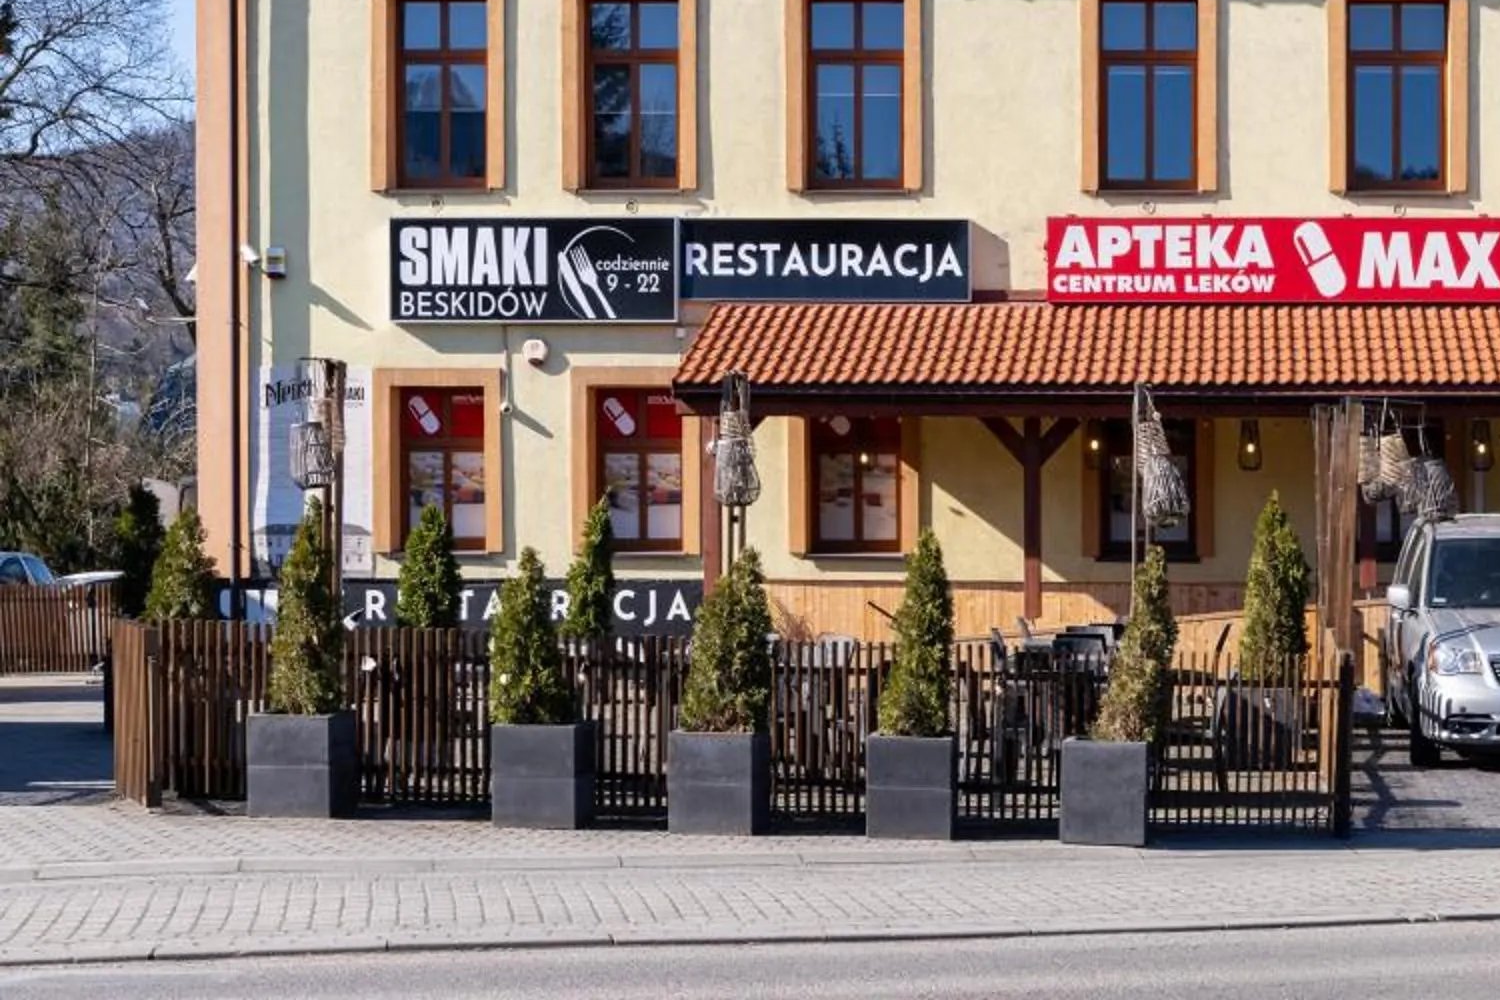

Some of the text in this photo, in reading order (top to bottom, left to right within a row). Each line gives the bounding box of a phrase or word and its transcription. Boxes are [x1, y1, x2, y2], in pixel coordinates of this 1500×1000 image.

[400, 226, 548, 286] SMAKI
[596, 254, 670, 273] codziennie
[685, 243, 963, 284] RESTAURACJA
[1054, 225, 1274, 269] APTEKA
[607, 274, 617, 293] 9
[637, 273, 661, 293] 22
[1053, 269, 1276, 294] CENTRUM LEKÓW
[400, 284, 548, 317] BESKIDÓW
[365, 588, 692, 626] RTARCJA
